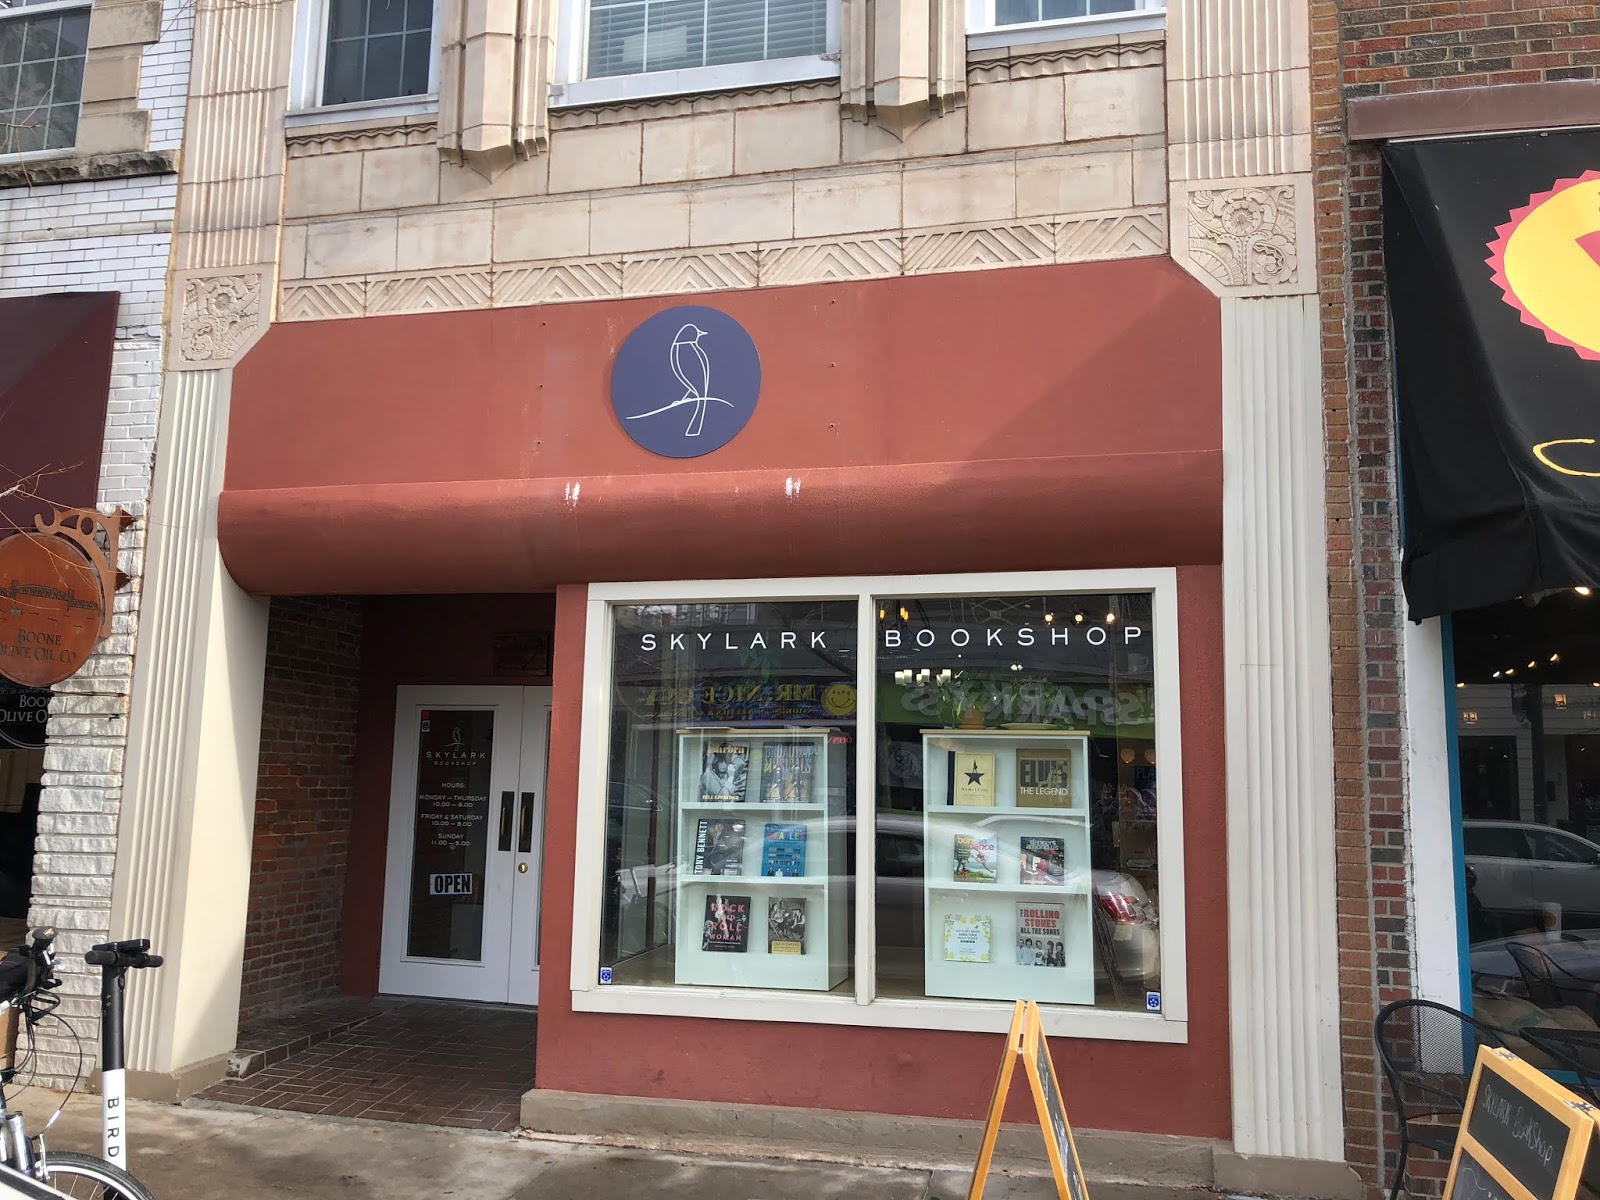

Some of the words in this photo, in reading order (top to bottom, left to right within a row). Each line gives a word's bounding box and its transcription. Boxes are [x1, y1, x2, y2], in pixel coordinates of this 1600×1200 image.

[18, 628, 62, 645] BOONE
[641, 631, 826, 651] SKYLARK
[885, 626, 1142, 647] BOOKSHOP
[35, 647, 55, 661] OIL
[19, 694, 50, 708] BOO
[426, 751, 486, 759] SKYLARK
[763, 758, 812, 773] MUSICALS
[1020, 787, 1034, 795] THE
[1035, 787, 1068, 796] LEGEND
[697, 821, 708, 853] BENNETT
[969, 842, 995, 851] dance
[694, 854, 704, 874] TONY
[434, 874, 472, 894] OPEN
[711, 903, 745, 912] ROCK
[1023, 909, 1060, 919] ROLLING
[711, 922, 742, 932] ROLL
[1024, 918, 1057, 928] STONES
[1042, 928, 1061, 936] SONGS
[107, 1096, 120, 1157] BIRD
